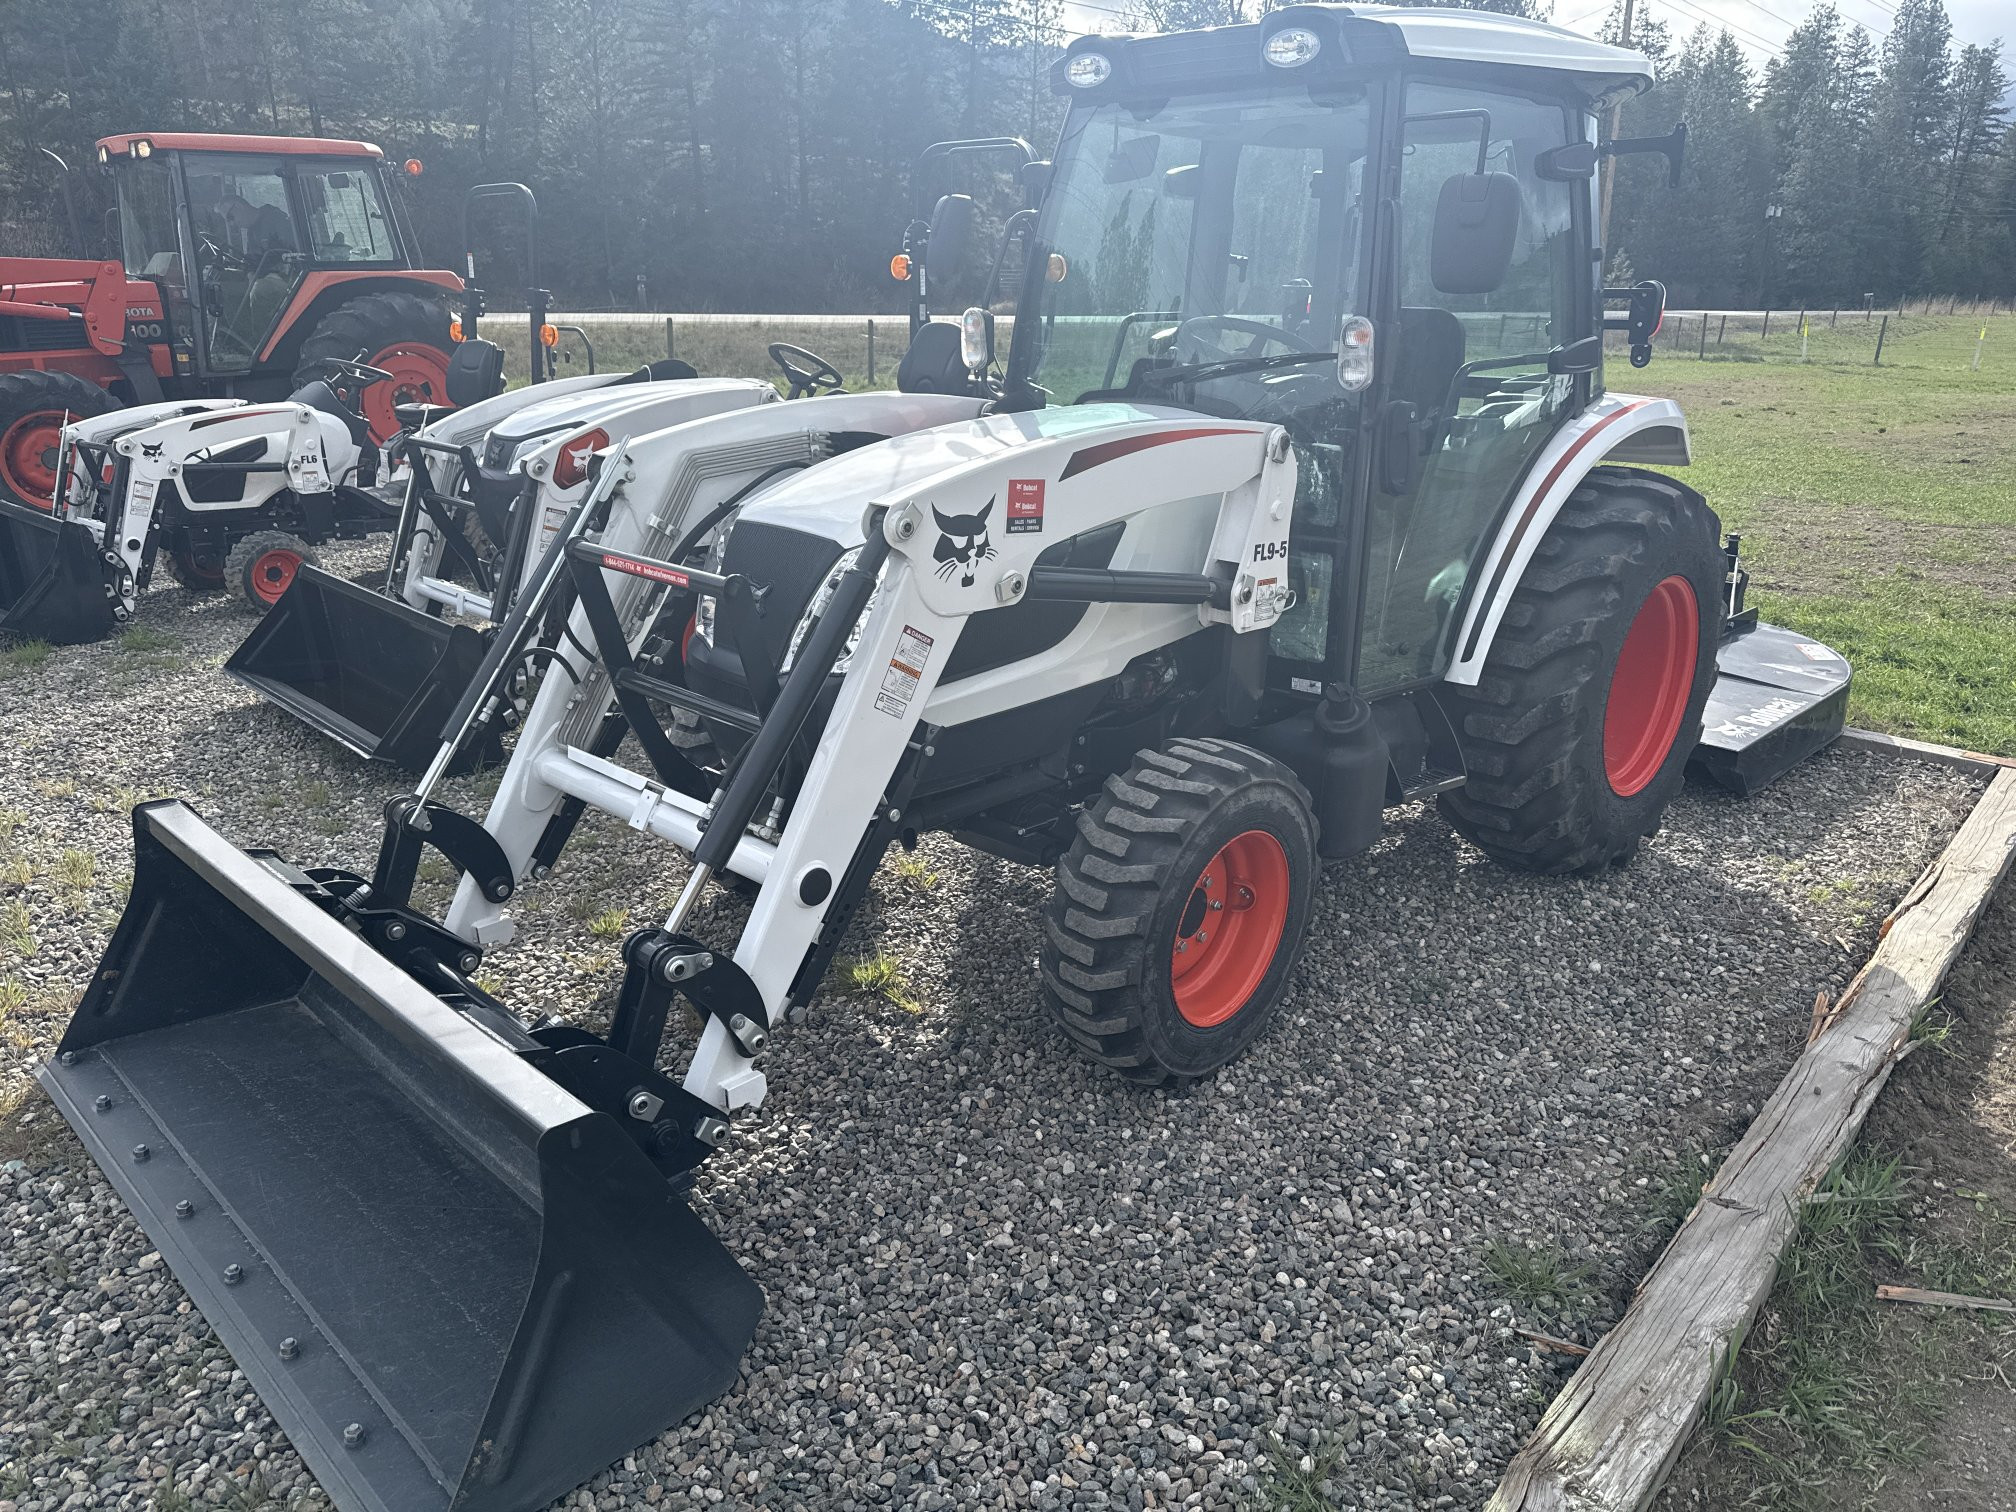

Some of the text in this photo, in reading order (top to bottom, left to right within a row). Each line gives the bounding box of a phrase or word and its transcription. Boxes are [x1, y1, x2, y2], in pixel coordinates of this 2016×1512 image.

[301, 455, 318, 464] FL6
[1253, 541, 1288, 562] FL9-5
[1735, 697, 1808, 727] Bobcat
